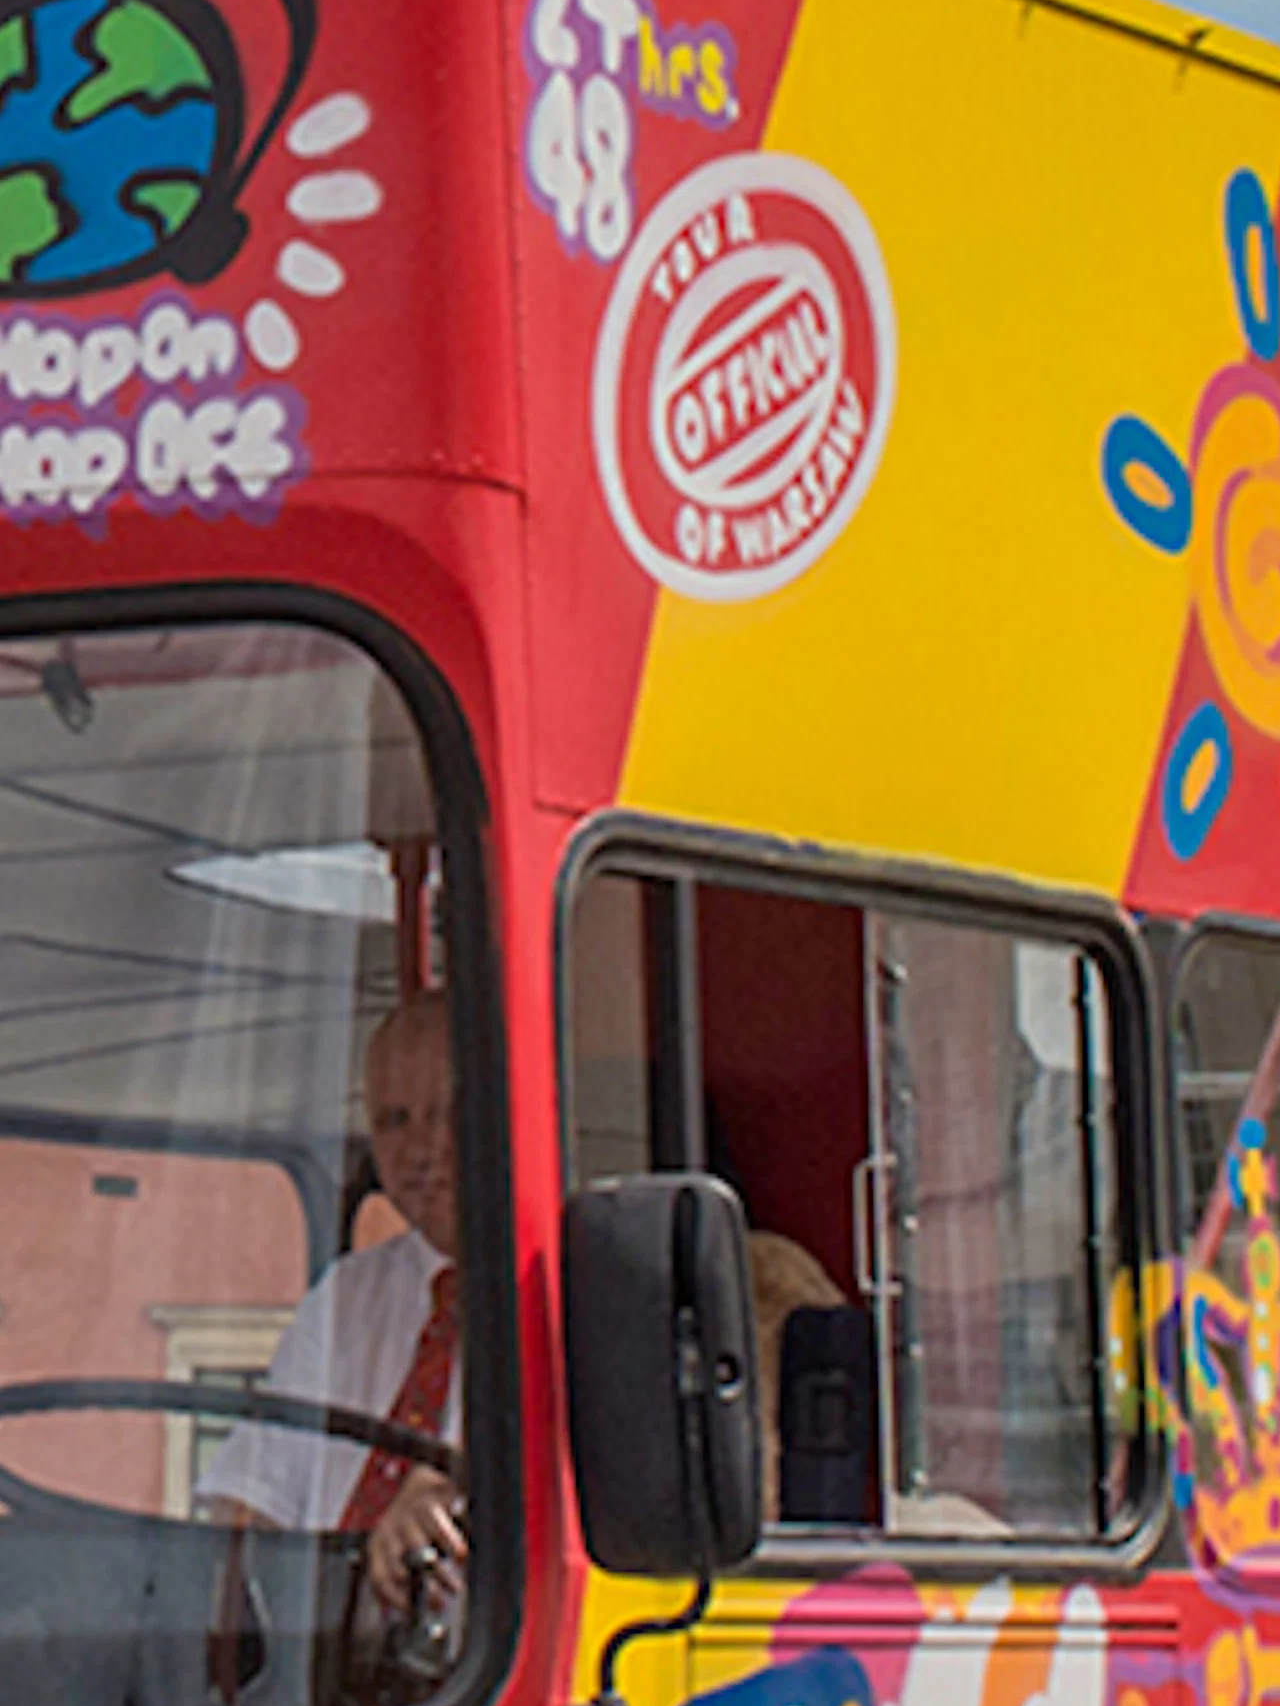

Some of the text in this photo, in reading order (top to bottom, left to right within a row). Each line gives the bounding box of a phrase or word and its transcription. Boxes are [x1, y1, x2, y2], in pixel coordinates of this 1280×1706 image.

[528, 69, 633, 260] 48
[674, 379, 867, 565] OF WARSAW
